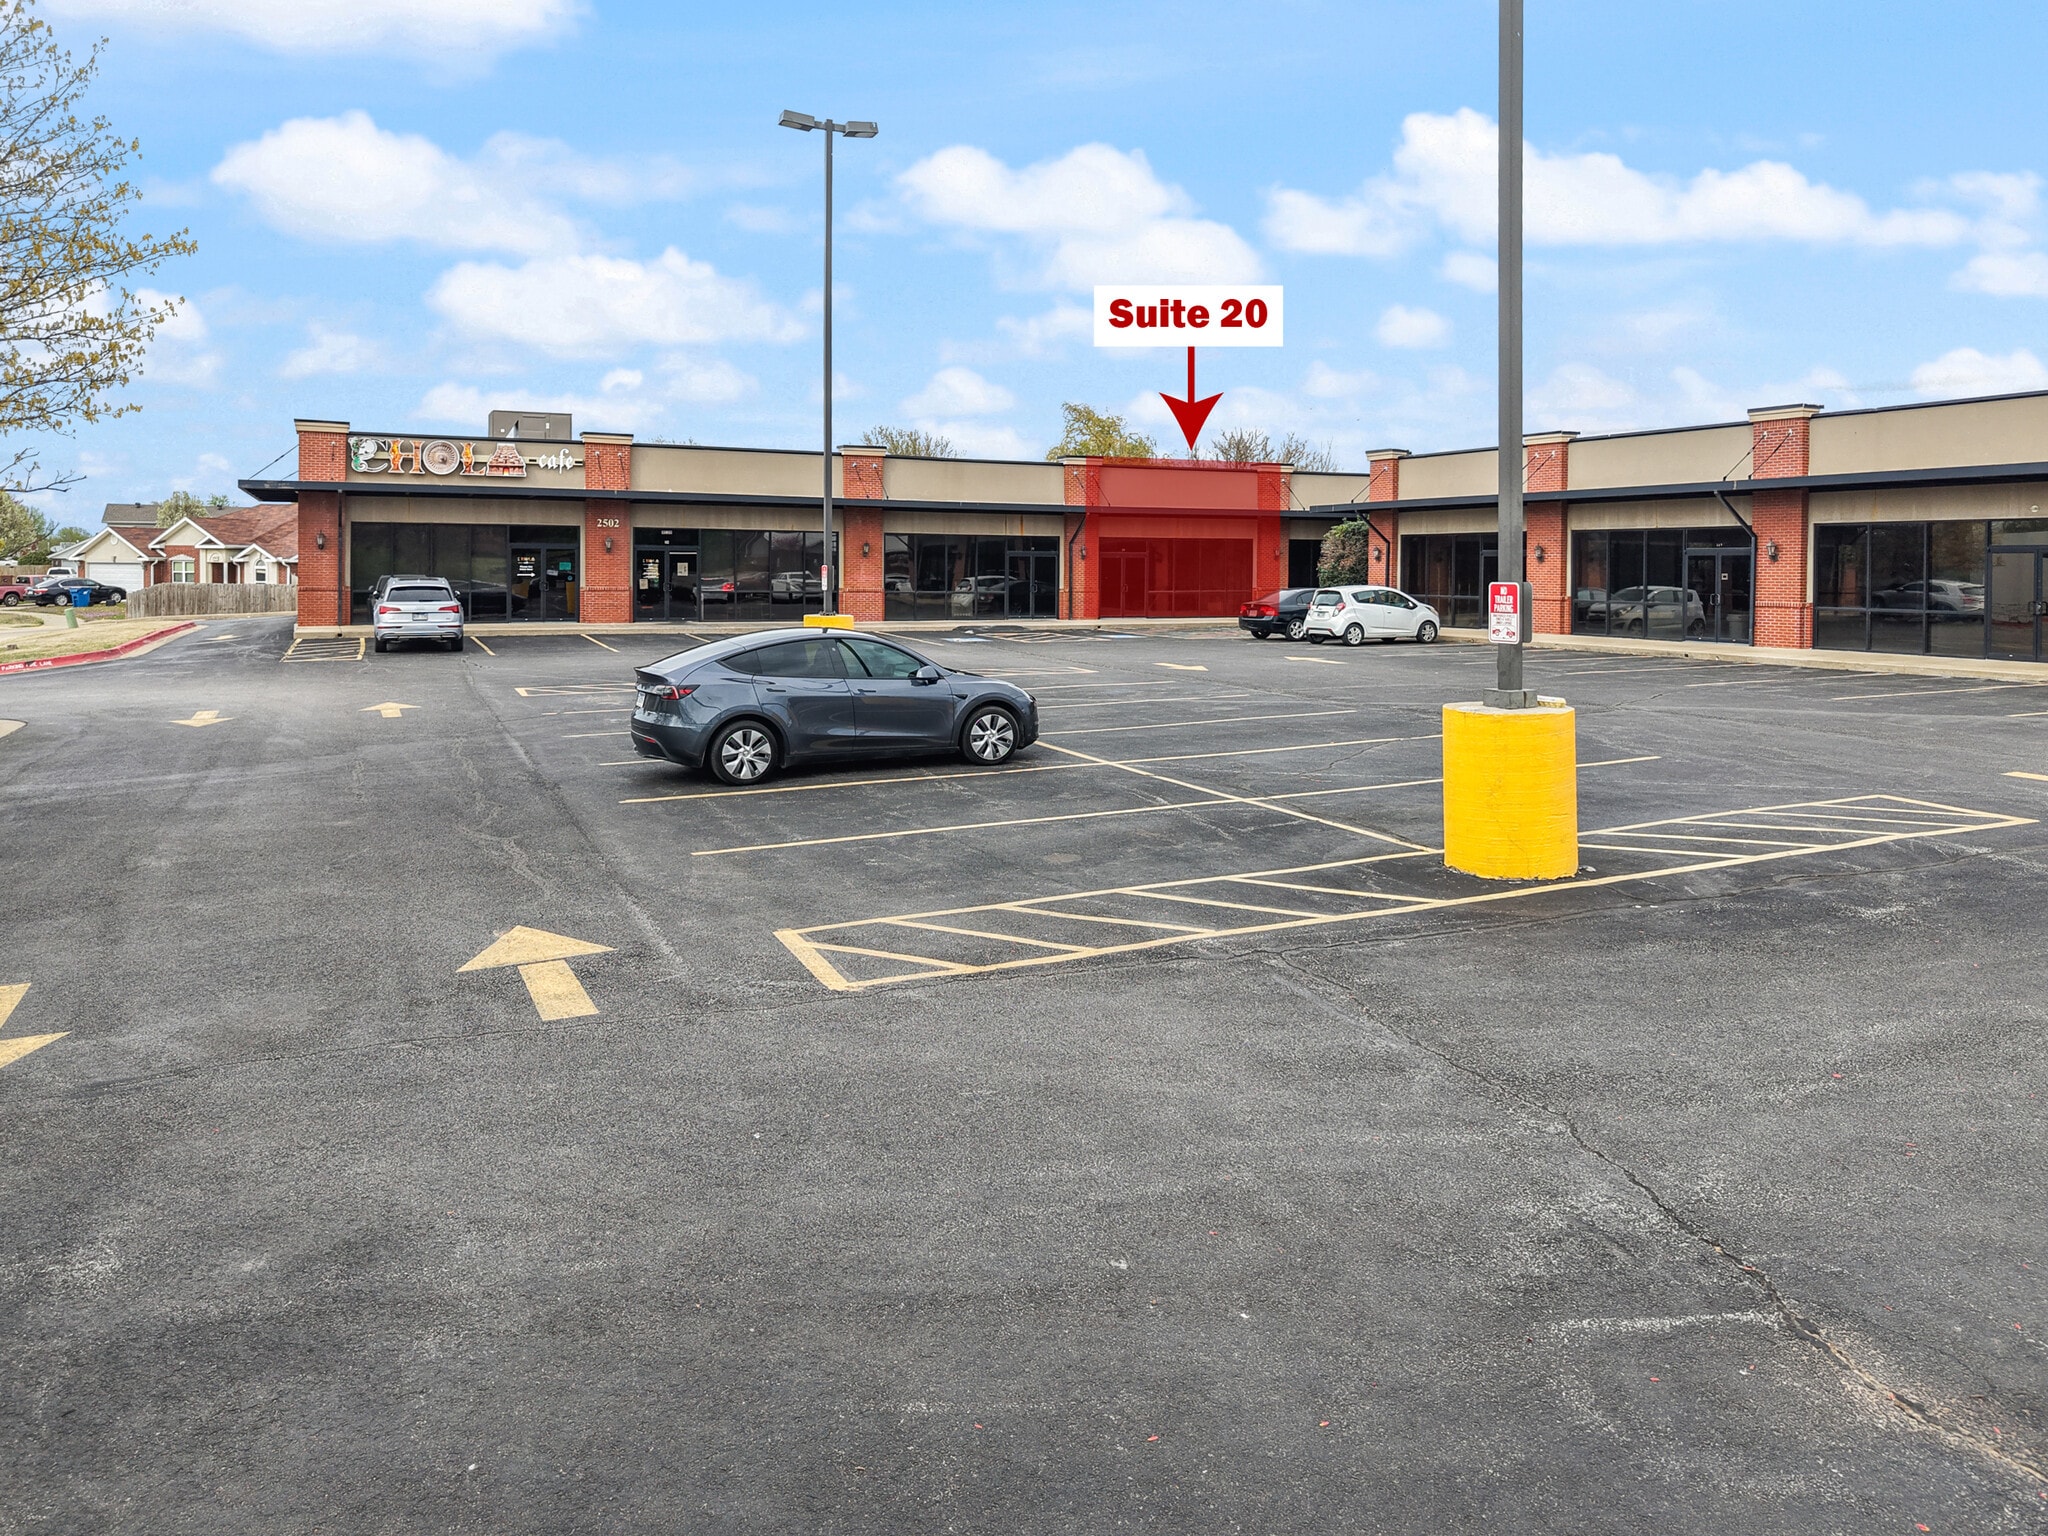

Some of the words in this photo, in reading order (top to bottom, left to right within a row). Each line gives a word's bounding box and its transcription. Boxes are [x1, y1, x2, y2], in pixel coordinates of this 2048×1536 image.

[348, 436, 527, 477] CHOLA
[596, 518, 620, 528] 2502
[1500, 586, 1508, 595] NO
[1494, 595, 1514, 604] TRAILER
[1493, 604, 1514, 613] PARKING
